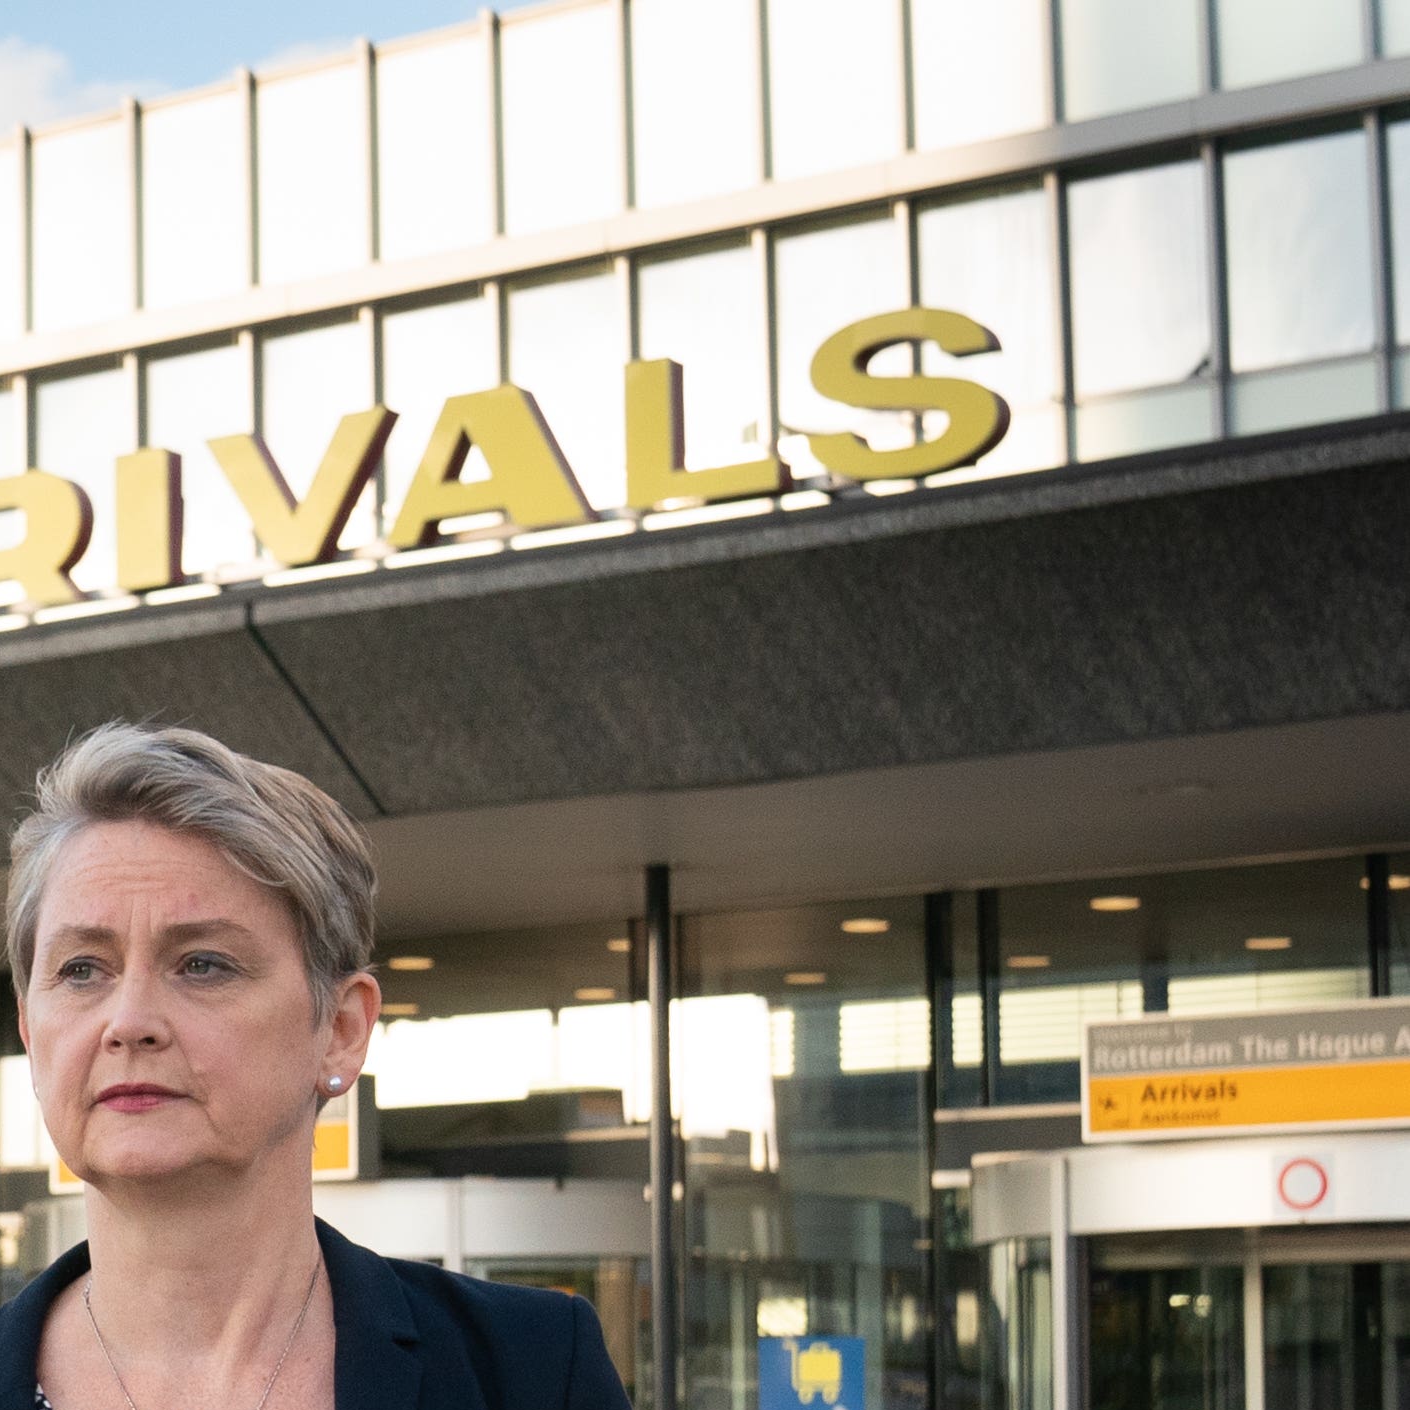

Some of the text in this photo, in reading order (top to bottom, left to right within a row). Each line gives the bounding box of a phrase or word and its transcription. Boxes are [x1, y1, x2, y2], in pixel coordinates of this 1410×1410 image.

[1094, 1040, 1232, 1070] Rotterdam
[1239, 1035, 1289, 1058] The
[1296, 1030, 1387, 1062] Hague
[1140, 1078, 1238, 1103] Arrivals
